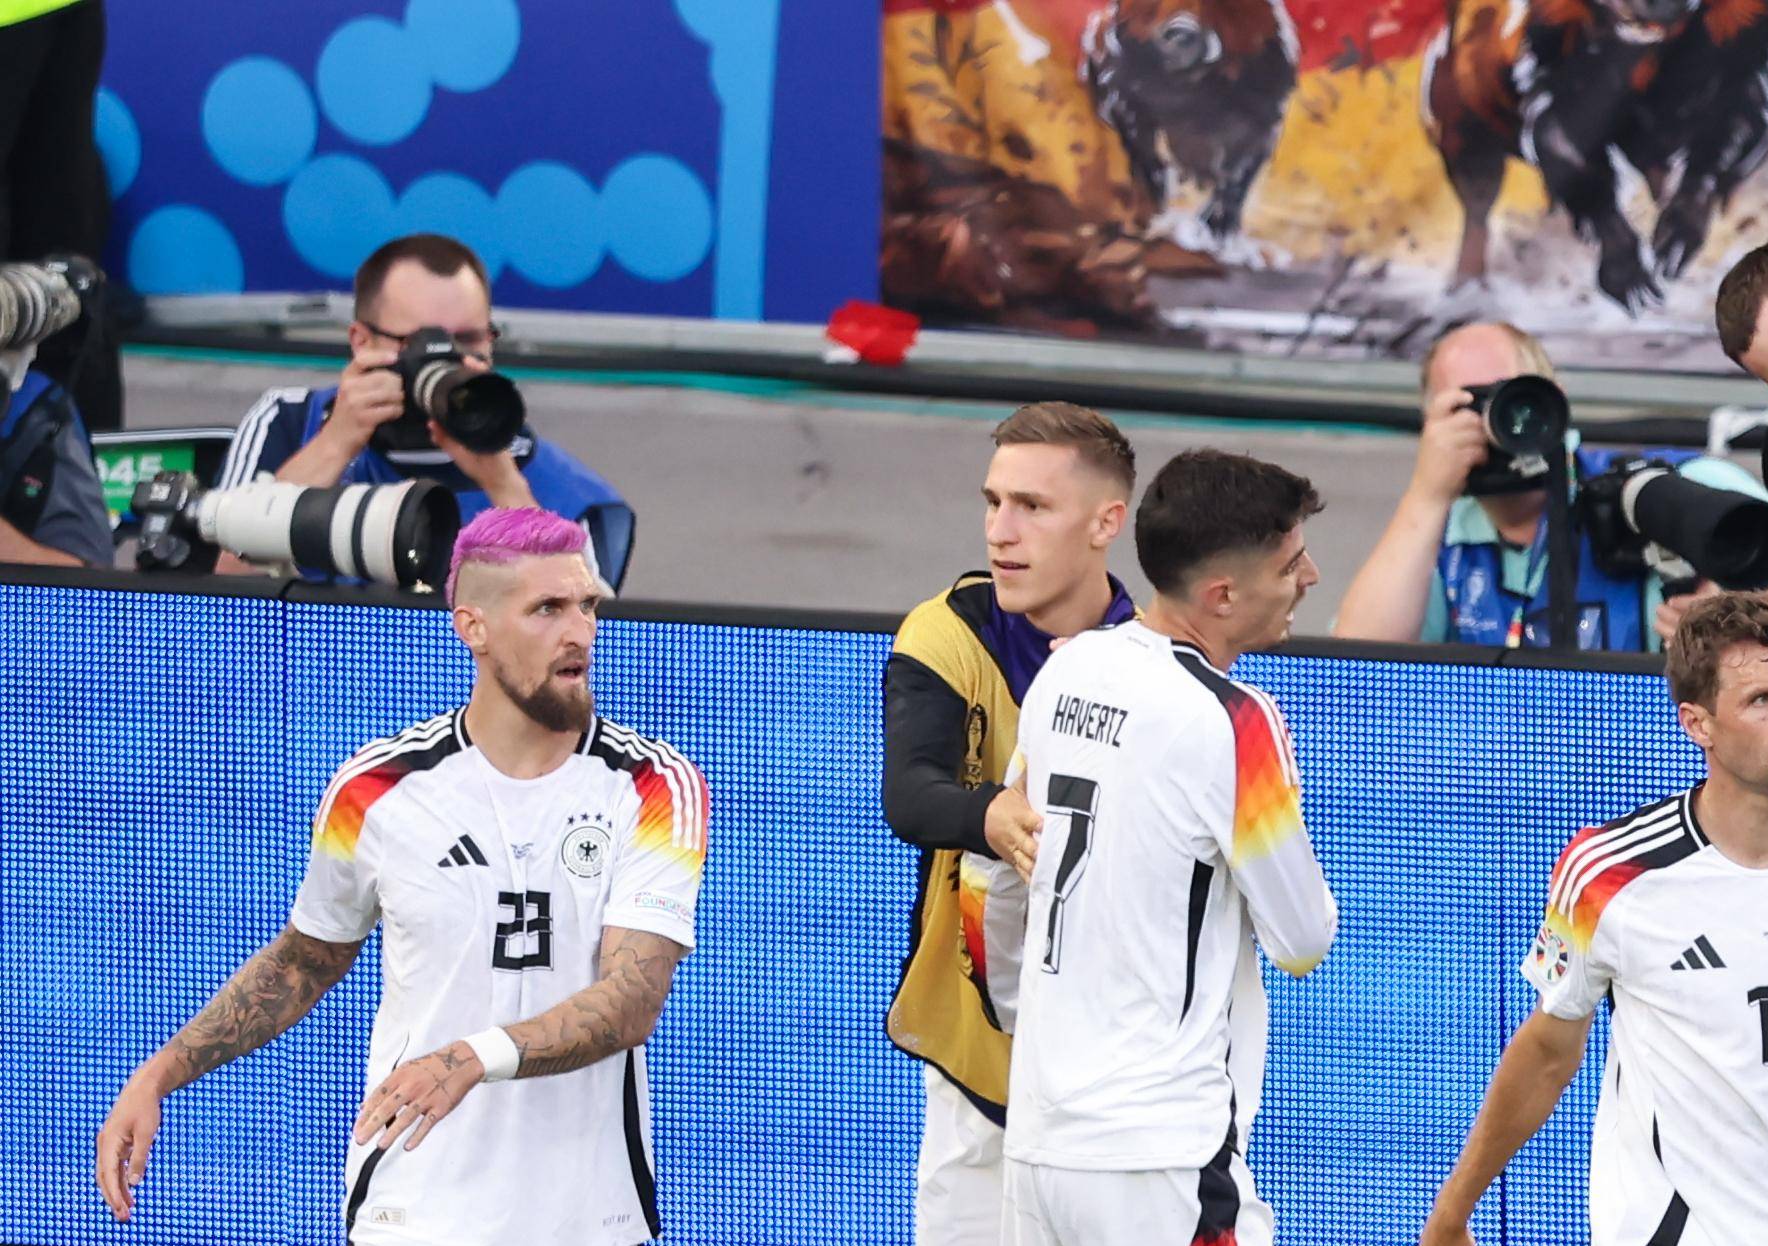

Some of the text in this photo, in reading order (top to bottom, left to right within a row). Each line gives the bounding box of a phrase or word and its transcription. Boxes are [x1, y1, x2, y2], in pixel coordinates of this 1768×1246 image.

[1052, 694, 1128, 748] HAVERTZ
[1041, 772, 1101, 975] 7
[492, 890, 554, 974] 23
